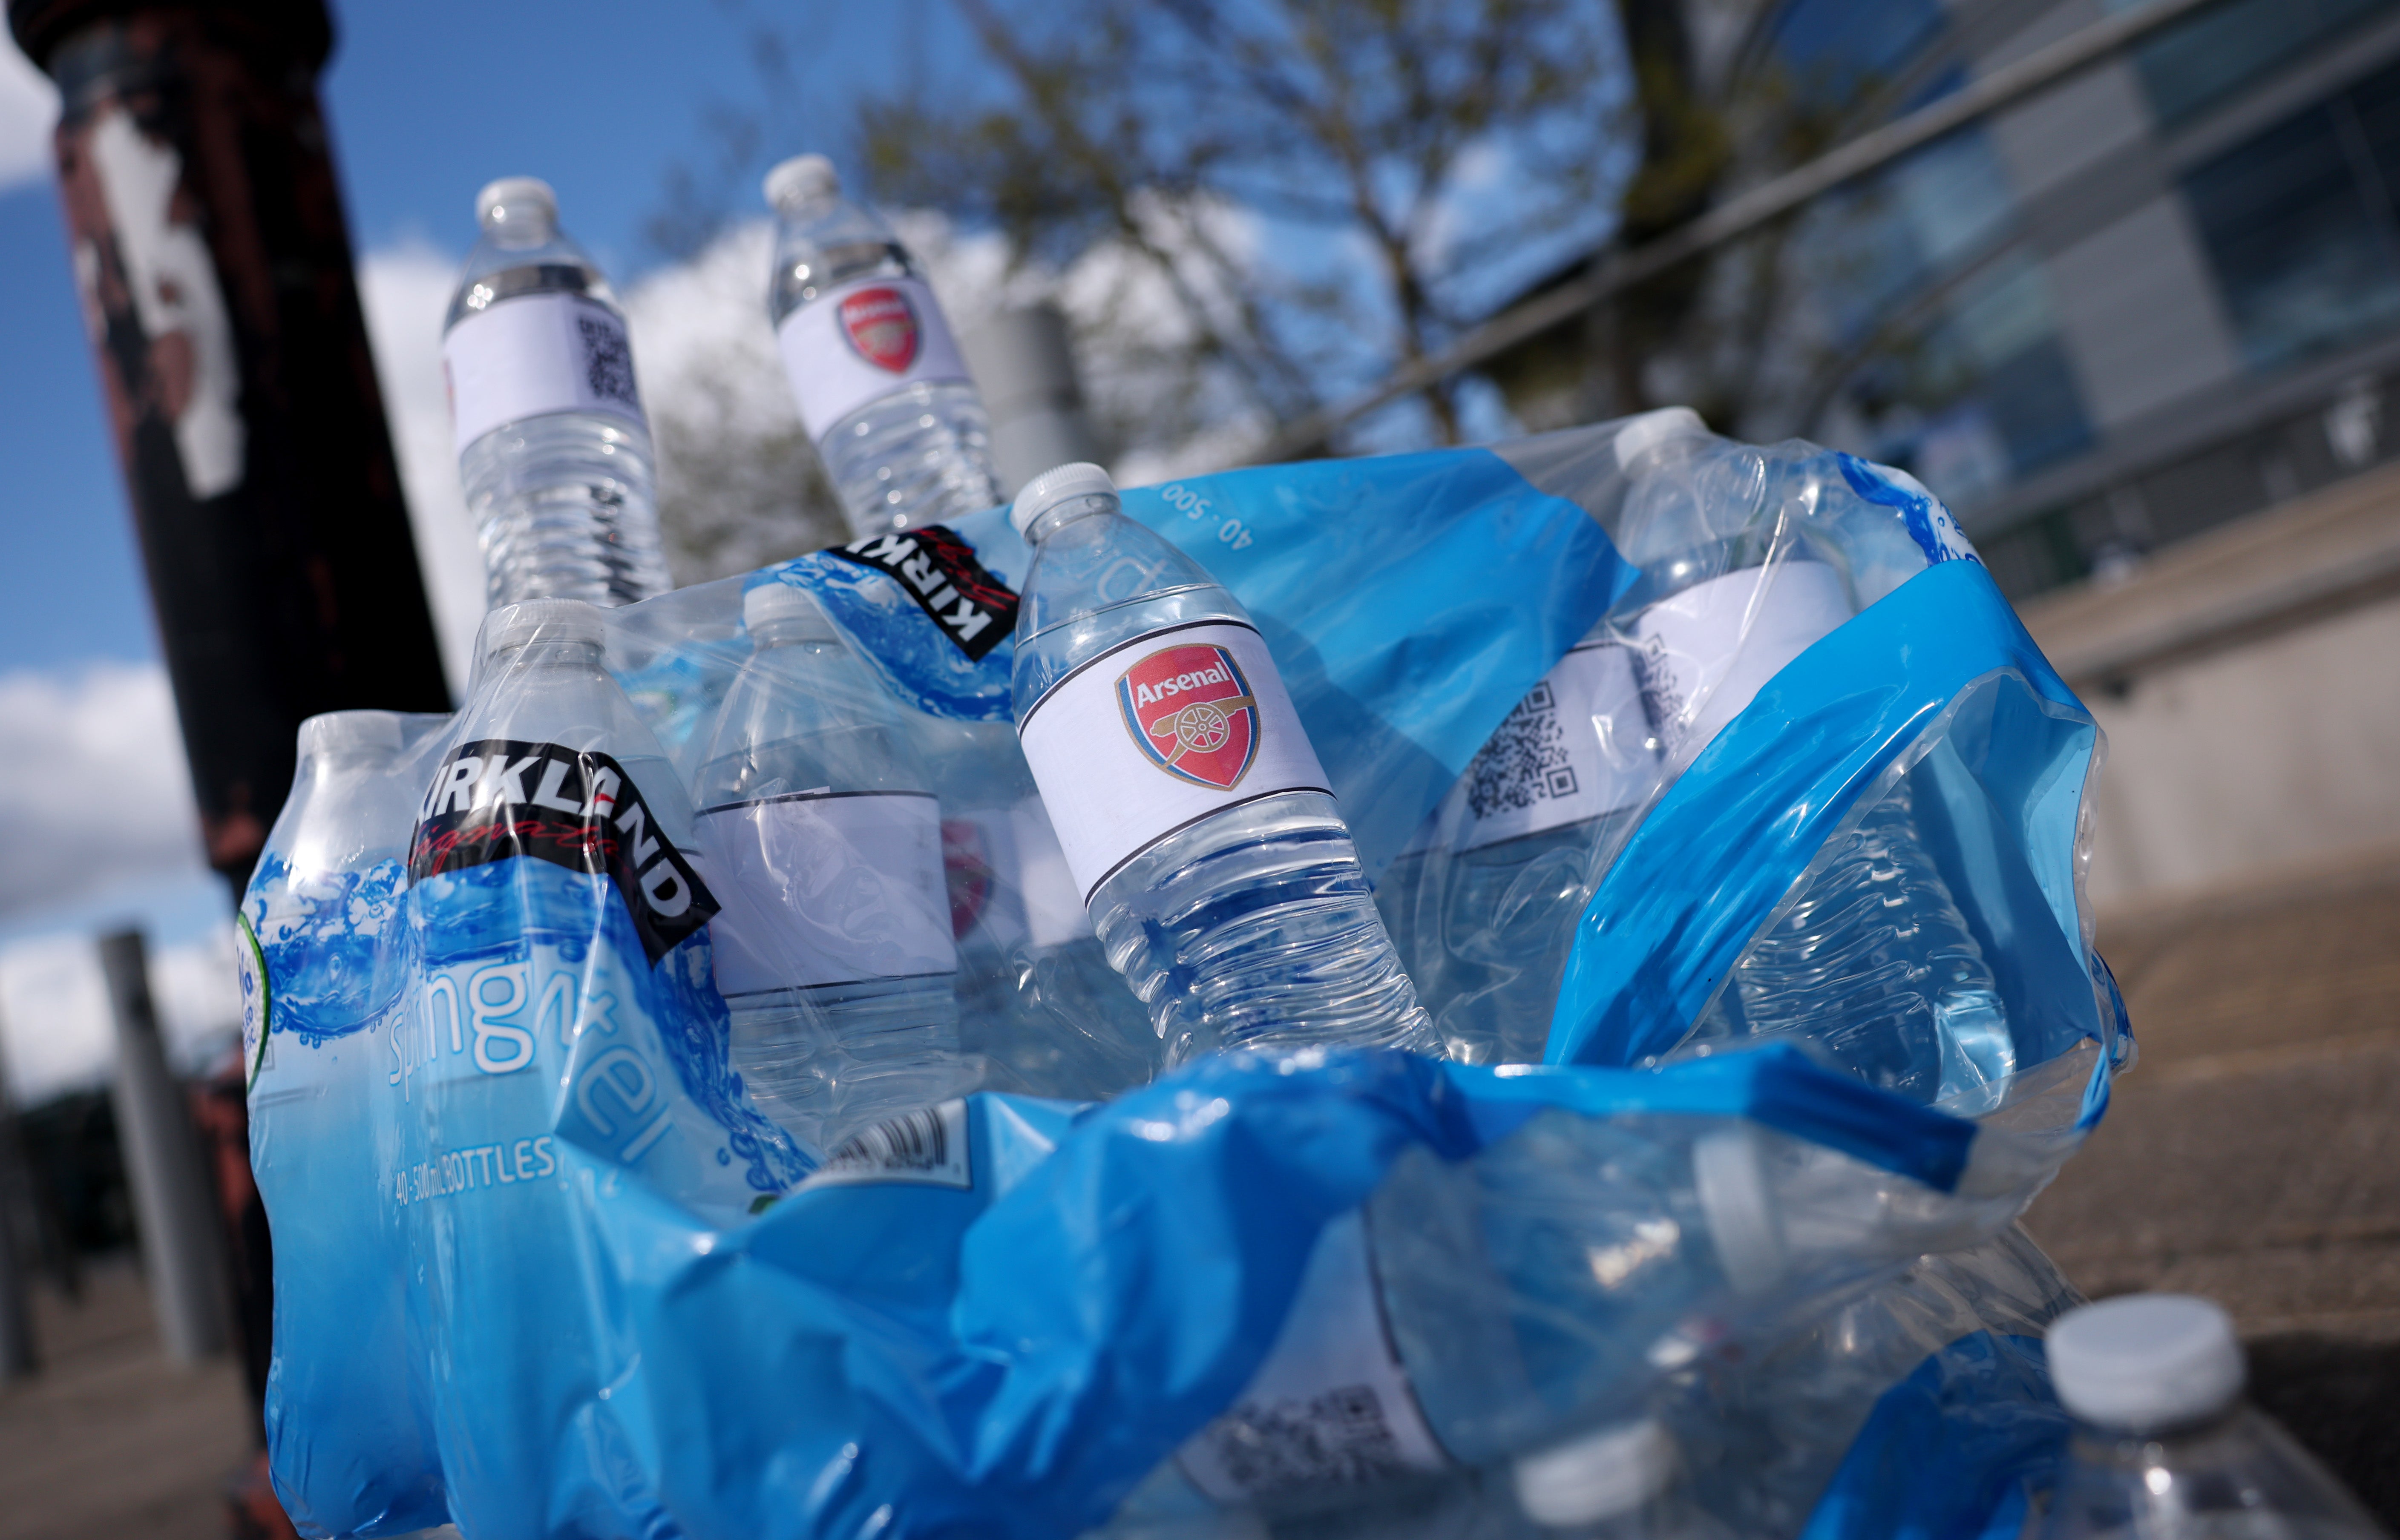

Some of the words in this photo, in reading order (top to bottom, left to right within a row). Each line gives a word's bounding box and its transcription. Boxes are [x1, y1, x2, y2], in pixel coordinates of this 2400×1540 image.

[1161, 483, 1212, 520] 500
[1218, 518, 1253, 550] 40
[1135, 661, 1230, 709] Arsenal
[417, 754, 692, 918] IRKLAND
[389, 959, 535, 1103] spring
[396, 1170, 408, 1206] 40
[413, 1162, 430, 1201] 500
[442, 1136, 555, 1193] BOTTLES
